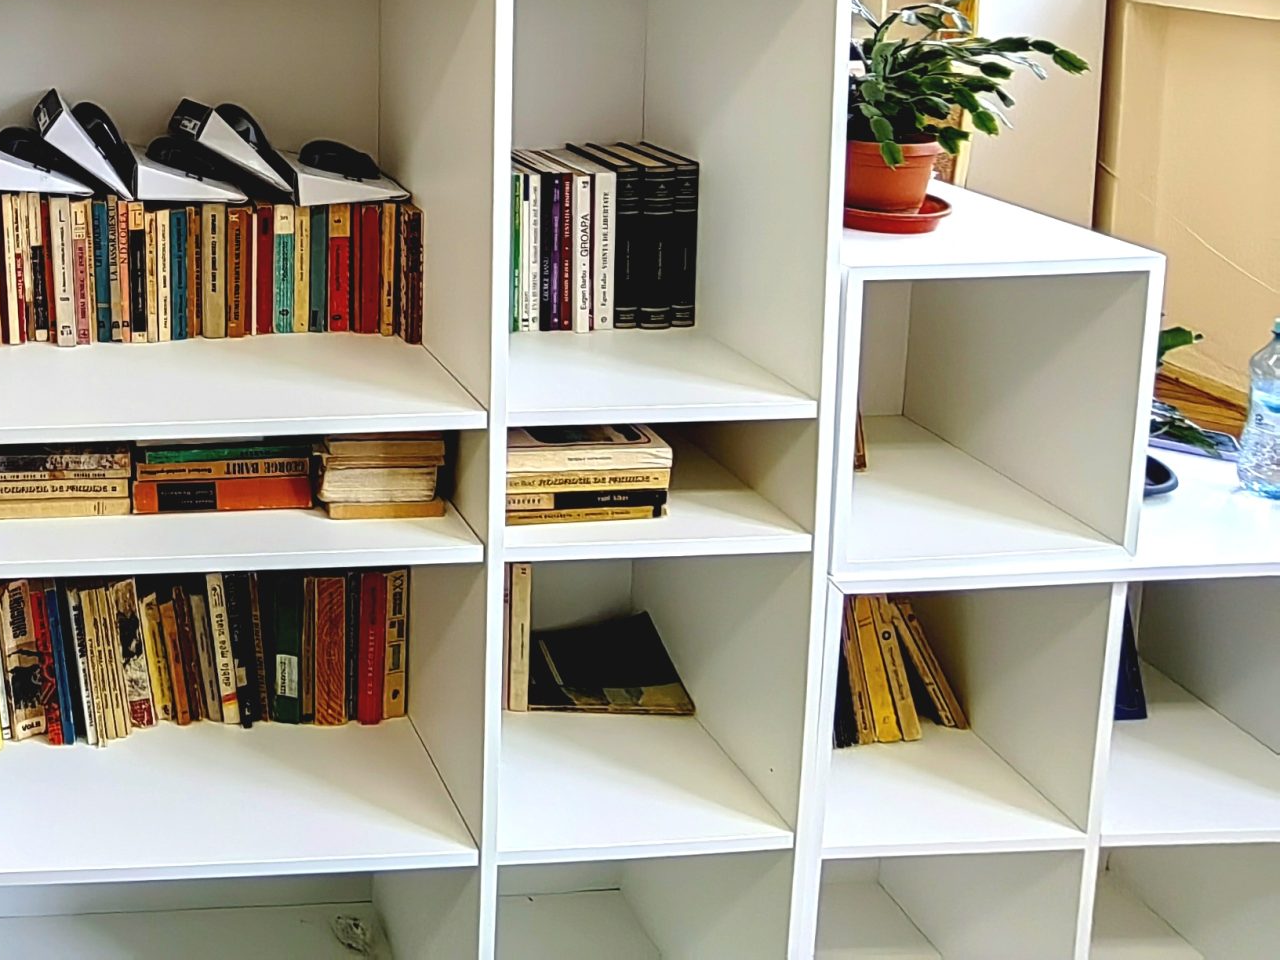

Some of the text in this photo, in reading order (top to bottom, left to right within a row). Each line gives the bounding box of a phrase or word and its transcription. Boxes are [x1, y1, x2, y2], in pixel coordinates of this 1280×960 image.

[107, 205, 117, 267] BASSARABESCU
[118, 211, 127, 247] COCEA
[601, 231, 609, 242] DE
[579, 213, 590, 311] Eugen Barbu GROAPA
[263, 460, 305, 474] GEORGE
[219, 639, 230, 659] mea
[221, 662, 231, 687] dubla
